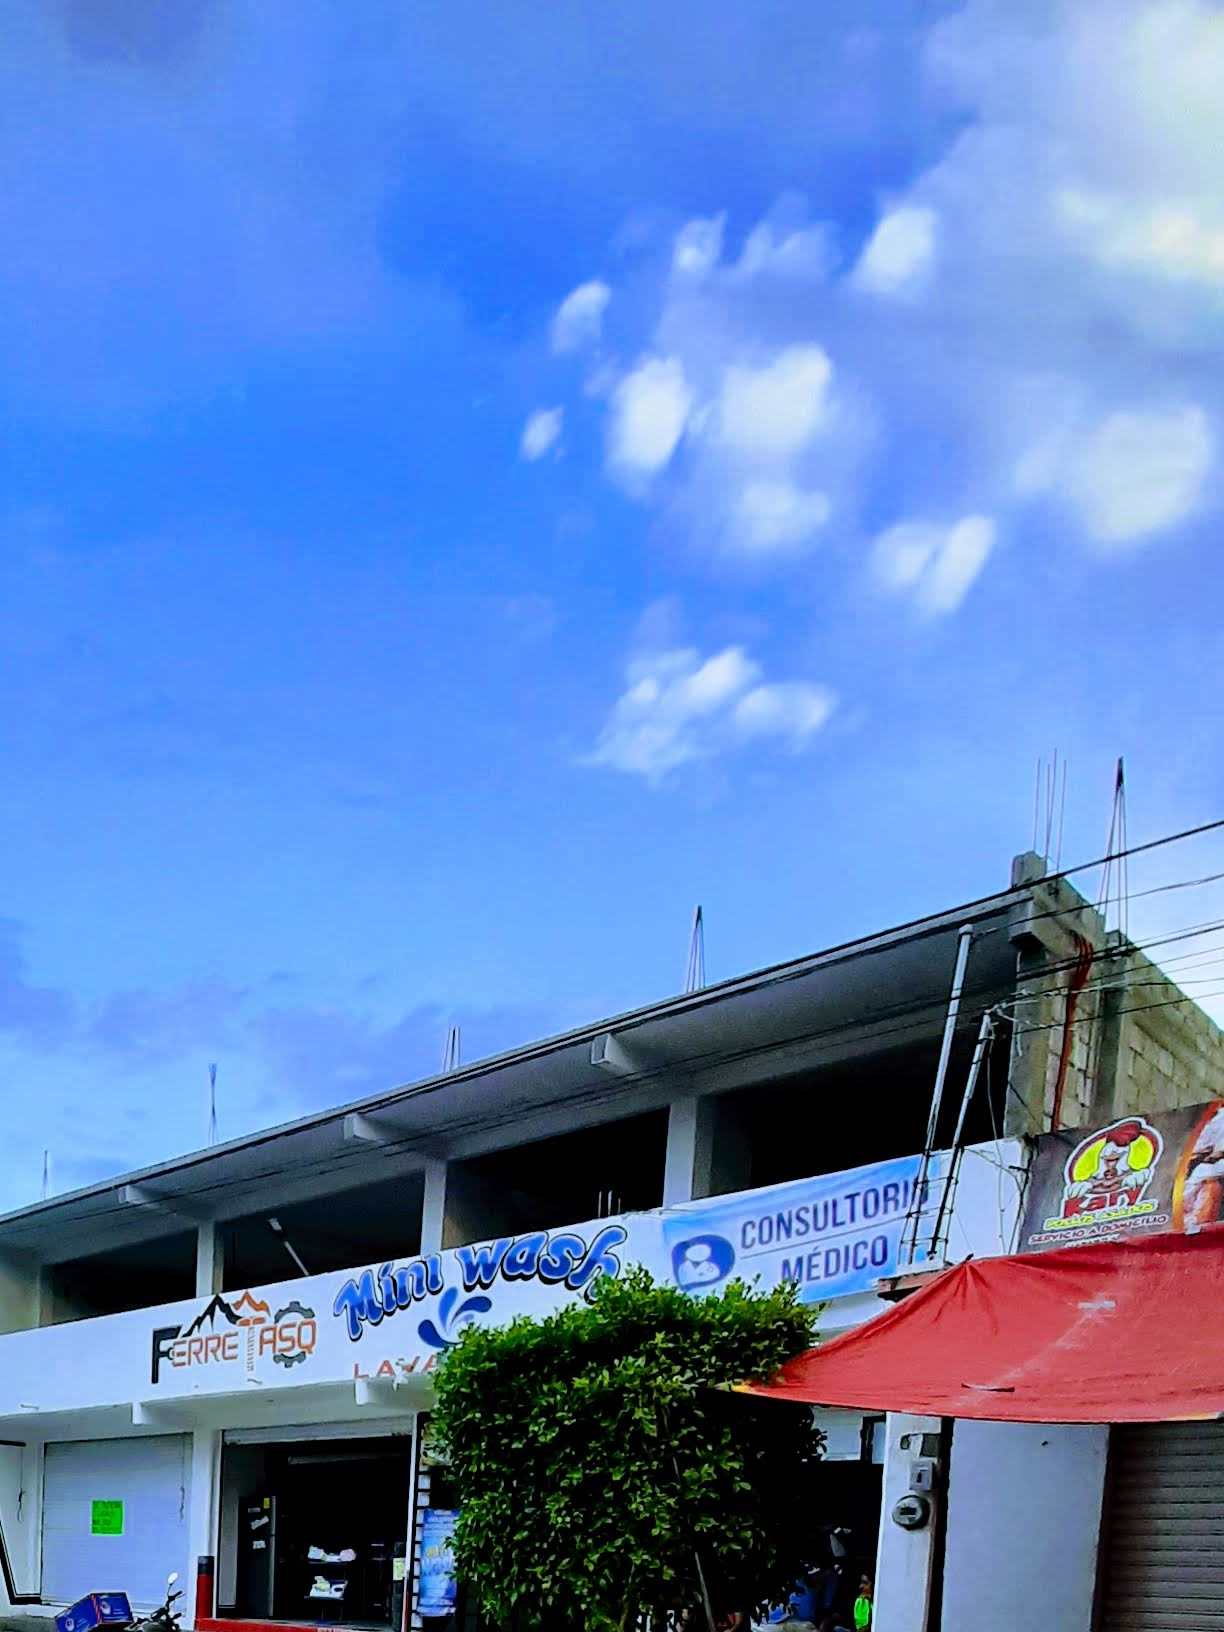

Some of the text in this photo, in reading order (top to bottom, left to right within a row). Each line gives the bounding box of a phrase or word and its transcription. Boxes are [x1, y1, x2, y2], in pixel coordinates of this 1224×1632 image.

[741, 1177, 929, 1250] CONSULTORIO
[1030, 1229, 1085, 1244] SERVICIO
[1100, 1214, 1169, 1235] DOMICILIO
[781, 1234, 889, 1285] MÉDICO
[333, 1252, 443, 1341] Mini
